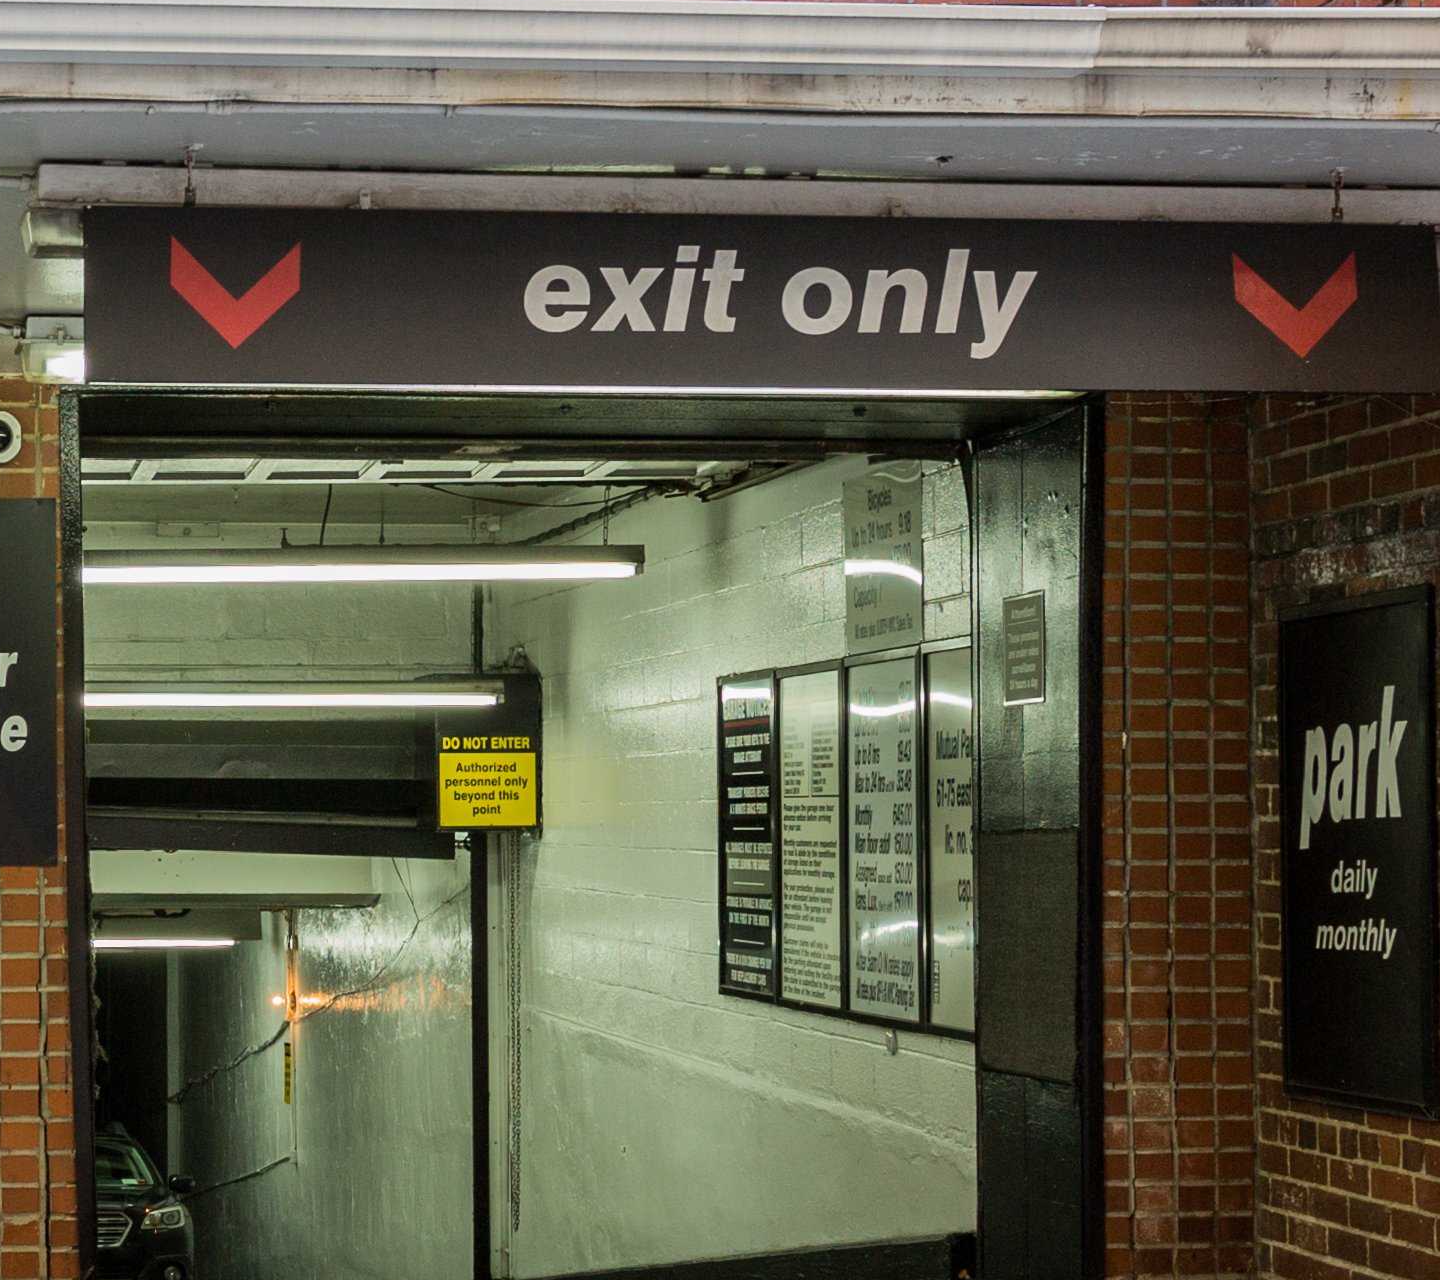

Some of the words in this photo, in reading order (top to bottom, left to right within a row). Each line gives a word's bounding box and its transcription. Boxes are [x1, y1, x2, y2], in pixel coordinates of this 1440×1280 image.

[524, 245, 745, 332] exit
[781, 248, 1038, 359] only
[442, 737, 460, 749] DO
[463, 737, 488, 749] NOT
[491, 736, 530, 749] ENTER
[456, 762, 517, 773] Authorized
[1299, 685, 1407, 849] park
[445, 776, 501, 789] personnel
[505, 777, 528, 789] only
[454, 790, 495, 803] beyond
[498, 790, 520, 800] this
[472, 805, 501, 817] point
[1331, 860, 1377, 900] daily
[1316, 919, 1397, 959] monthly
